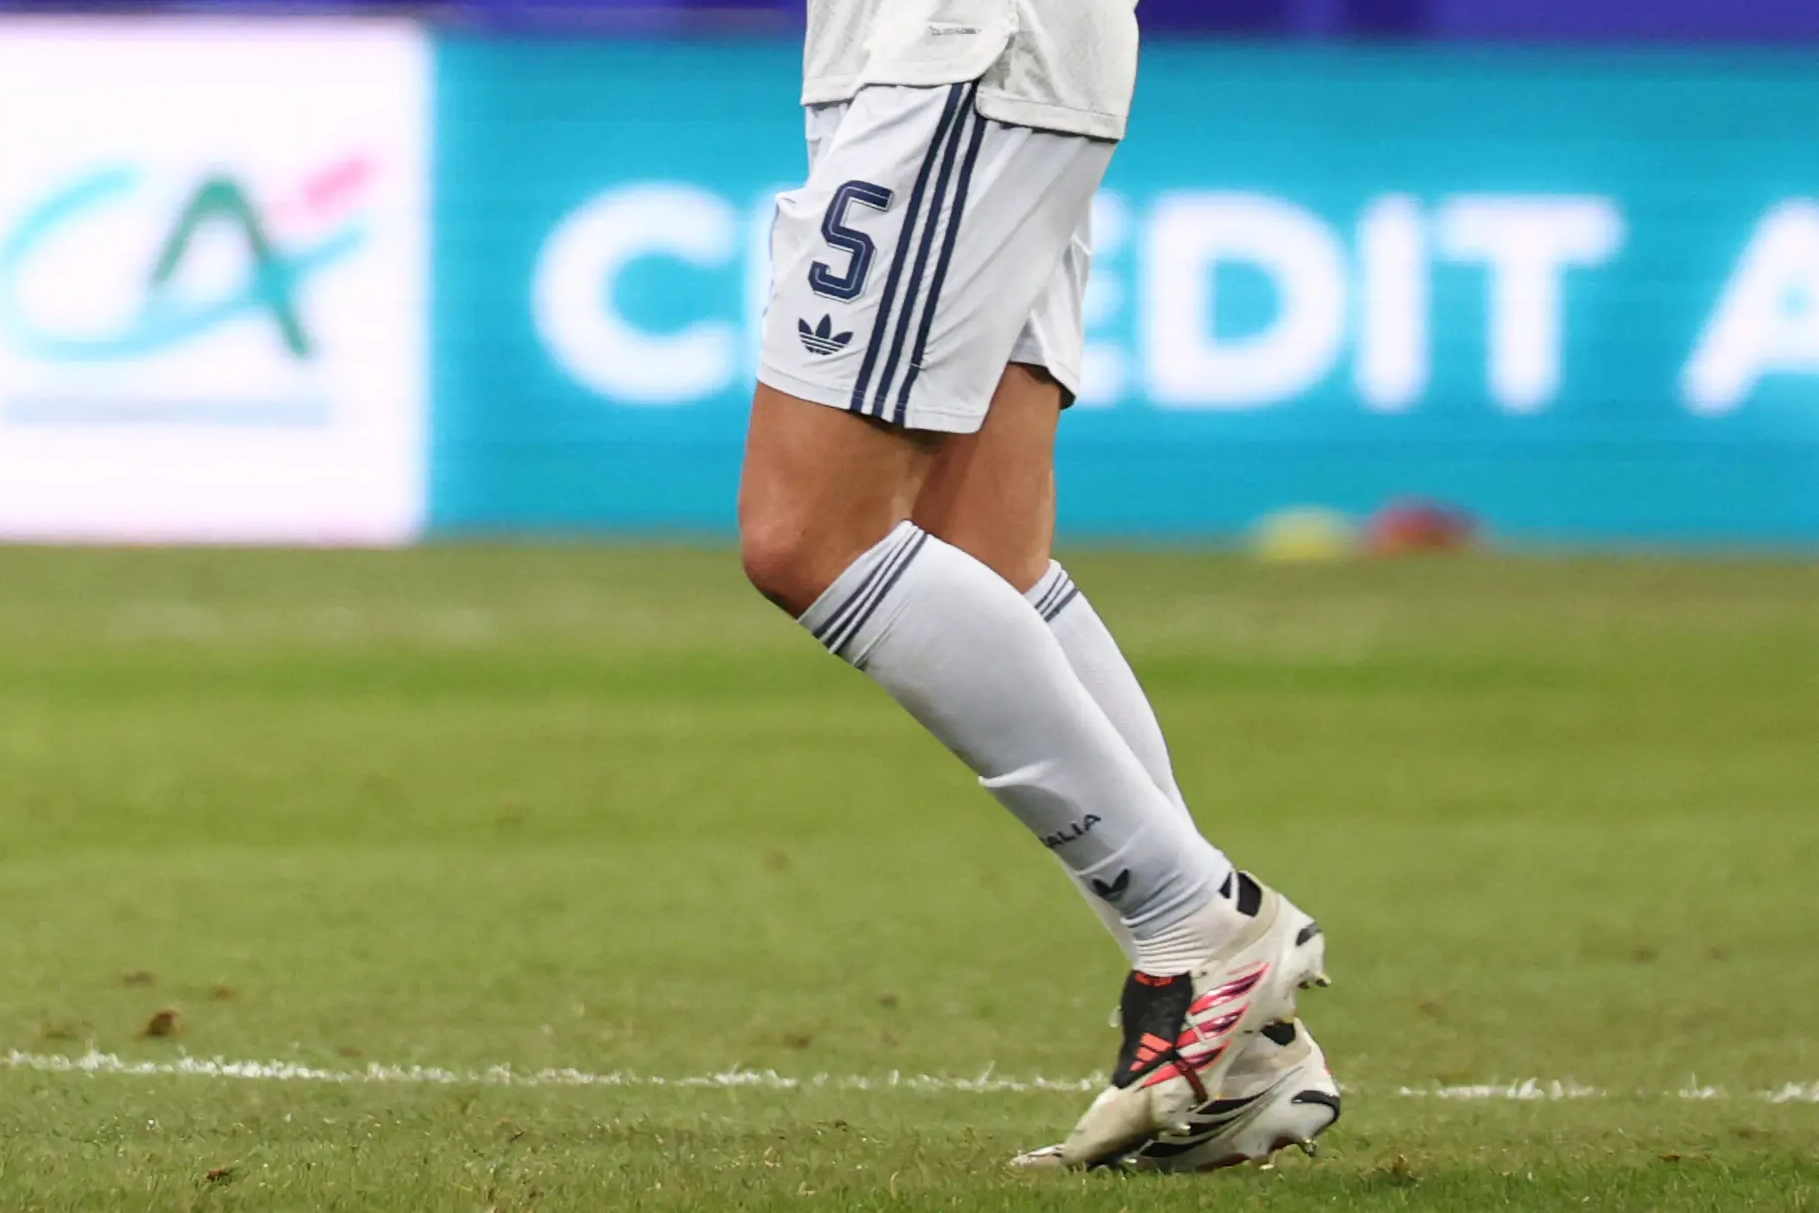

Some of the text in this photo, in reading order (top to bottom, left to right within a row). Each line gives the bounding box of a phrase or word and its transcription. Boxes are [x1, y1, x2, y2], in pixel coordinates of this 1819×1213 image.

[532, 183, 1622, 412] CDIT
[808, 180, 893, 304] 5
[1039, 814, 1101, 848] ALIA
